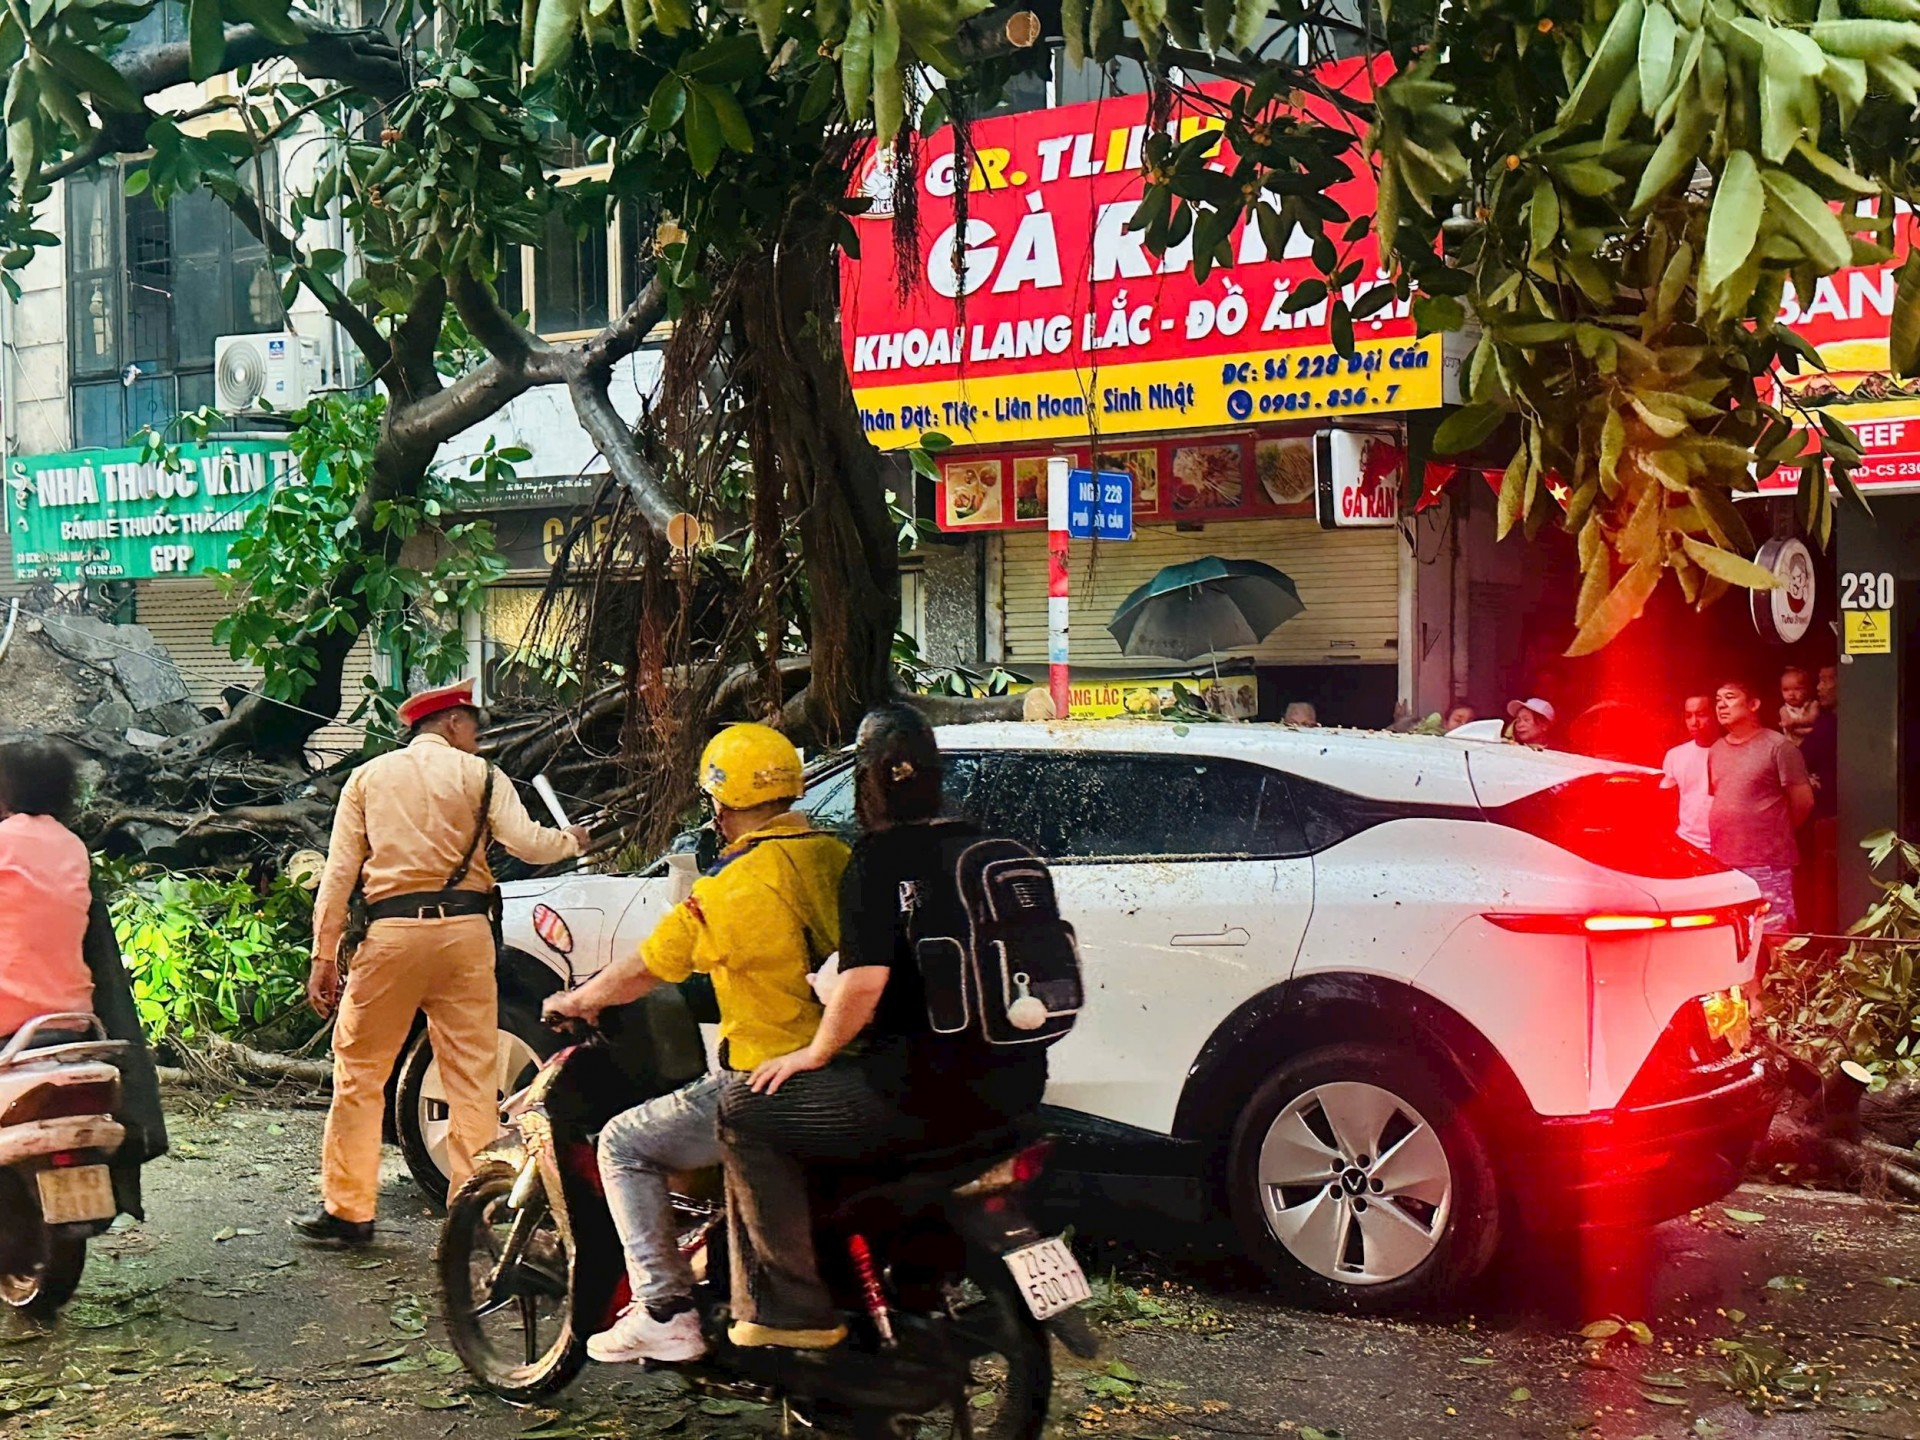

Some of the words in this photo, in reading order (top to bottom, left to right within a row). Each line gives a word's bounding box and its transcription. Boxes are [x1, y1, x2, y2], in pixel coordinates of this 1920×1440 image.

[926, 189, 1063, 298] GÀ
[853, 326, 964, 373] KHOAI
[970, 314, 1073, 362] LANG
[1082, 288, 1154, 351] LẮC
[1186, 276, 1249, 340] ĐỒ
[1222, 362, 1258, 385] ĐC:
[1264, 354, 1291, 381] Số
[1295, 354, 1340, 379] 228
[1347, 348, 1383, 381] Đội
[1389, 342, 1429, 370] Cấn
[995, 396, 1031, 422] Liên
[1037, 394, 1083, 420] Hoan
[1103, 385, 1142, 414] Sinh
[1149, 382, 1195, 415] Nhật
[1849, 424, 1905, 447] EEF
[36, 457, 100, 507] NHÀ
[201, 446, 266, 496] VÂN
[61, 513, 97, 540] BÁN
[121, 505, 180, 537] THUỐC
[151, 543, 194, 573] GPP
[1840, 571, 1895, 610] 230
